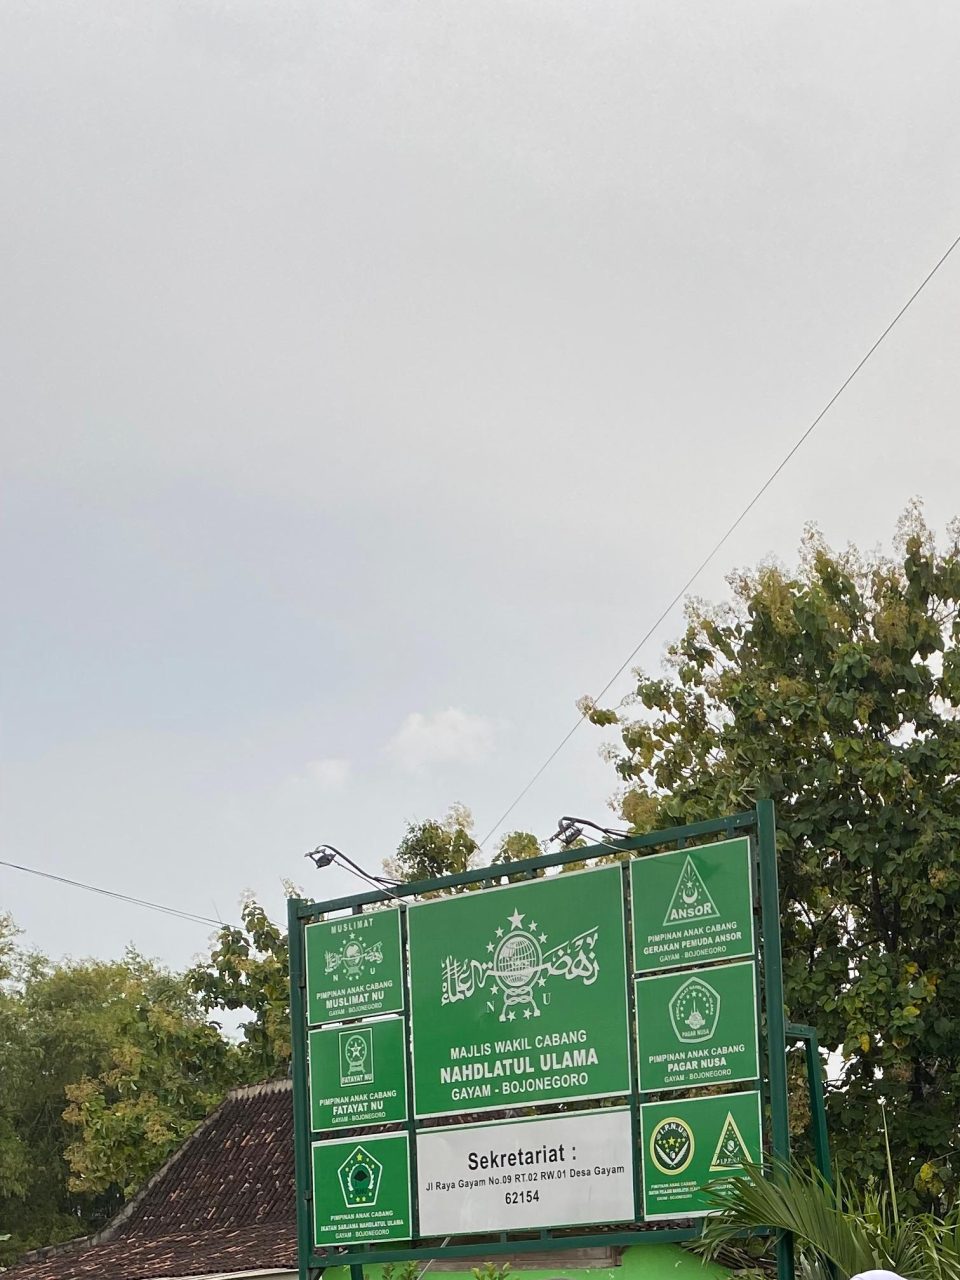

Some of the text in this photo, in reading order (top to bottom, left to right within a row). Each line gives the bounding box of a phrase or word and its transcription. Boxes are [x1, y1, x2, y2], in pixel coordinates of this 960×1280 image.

[670, 902, 712, 920] ANSOR
[331, 918, 373, 934] MUSLIMAT
[648, 922, 737, 943] PIMPINAN ANAK CABANG
[643, 932, 742, 955] GERAKAN PEMUDA ANSOR
[660, 954, 679, 962] GAYAM
[685, 946, 726, 958] BOJONEGORO
[316, 980, 393, 1000] PIMPINAN ANAK CABANG
[326, 991, 384, 1009] MUSLIMAT NU
[487, 993, 551, 1013] N U
[450, 1030, 587, 1059] MAJLIS WAKIL CABANG
[649, 1044, 745, 1063] PIMPINAN ANAK CABANG
[440, 1048, 598, 1084] NAHDLATUL ULAMA
[668, 1057, 727, 1073] PAGAR NUSA
[342, 1075, 363, 1084] FATAYAT
[664, 1074, 684, 1083] GAYAM
[689, 1069, 731, 1080] BOJONEGORO
[452, 1085, 491, 1100] GAYAM
[502, 1072, 588, 1094] BOJONEGORO
[320, 1090, 397, 1106] PIMPINAN ANAK CABANG
[333, 1101, 384, 1115] FATAYAT NU
[468, 1144, 565, 1171] Sekretariat
[426, 1165, 625, 1191] Jl Raya Gayam No.09 RT.02 RW.01 Desa Gayam
[505, 1190, 539, 1204] 62154
[331, 1213, 354, 1221] PIMPINAN
